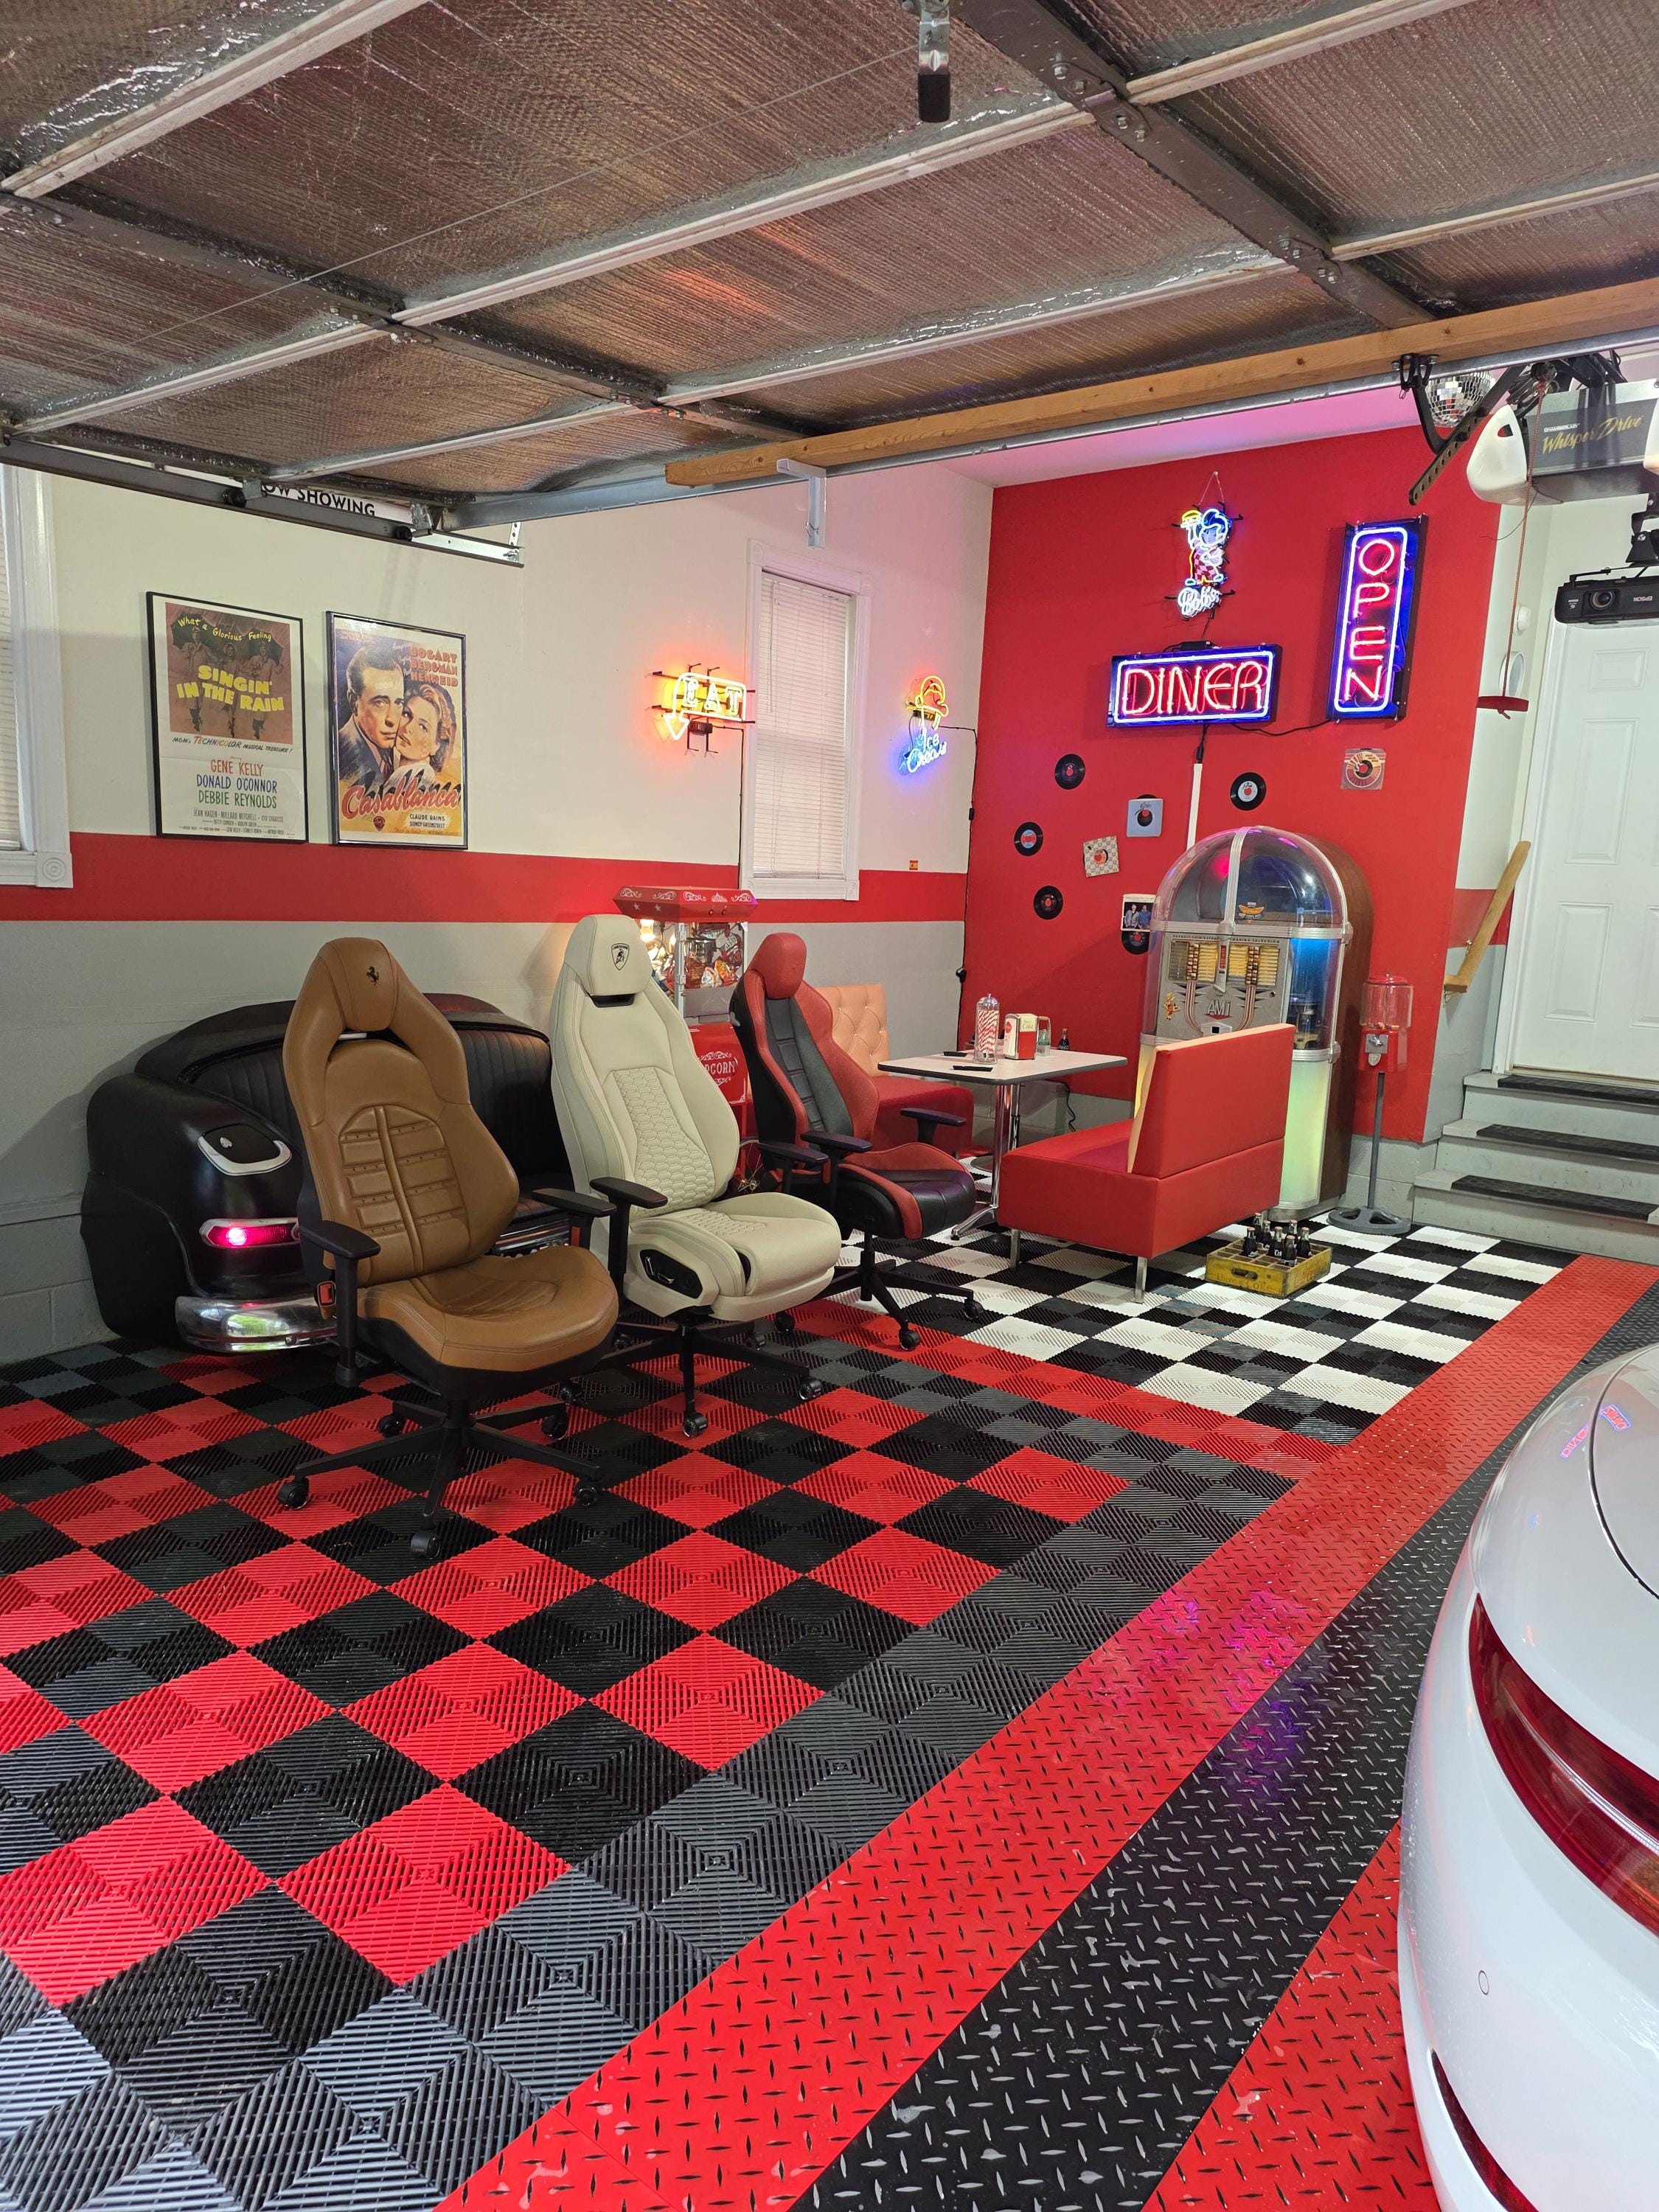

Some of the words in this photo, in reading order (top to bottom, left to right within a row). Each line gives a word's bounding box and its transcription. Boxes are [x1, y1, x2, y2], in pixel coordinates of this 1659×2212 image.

[1543, 428, 1597, 454] Whisper
[1597, 415, 1642, 440] Drive
[297, 489, 375, 516] SHOWING
[178, 616, 201, 627] What
[212, 627, 243, 641] Glorious
[248, 631, 271, 641] Feeling
[1345, 539, 1394, 700] OPEN
[410, 647, 458, 664] BOGART
[410, 660, 458, 675] BERGMAN
[198, 665, 273, 695] SINGIN'
[1123, 661, 1265, 714] DINER
[176, 681, 200, 698] IN
[202, 682, 234, 705] THE
[240, 695, 285, 712] RAIN
[682, 678, 742, 716] EAT
[193, 736, 243, 748] TECHNICOLOR
[921, 727, 939, 752] Ice
[211, 759, 234, 774] GENE
[239, 762, 264, 776] KELLY
[197, 774, 232, 790] DONALD
[236, 777, 277, 793] O'CONNOR
[198, 790, 230, 805] DEBBIE
[234, 793, 277, 809] REYNOLDS
[341, 775, 460, 820] Casablanca
[705, 1062, 736, 1074] PCORN
